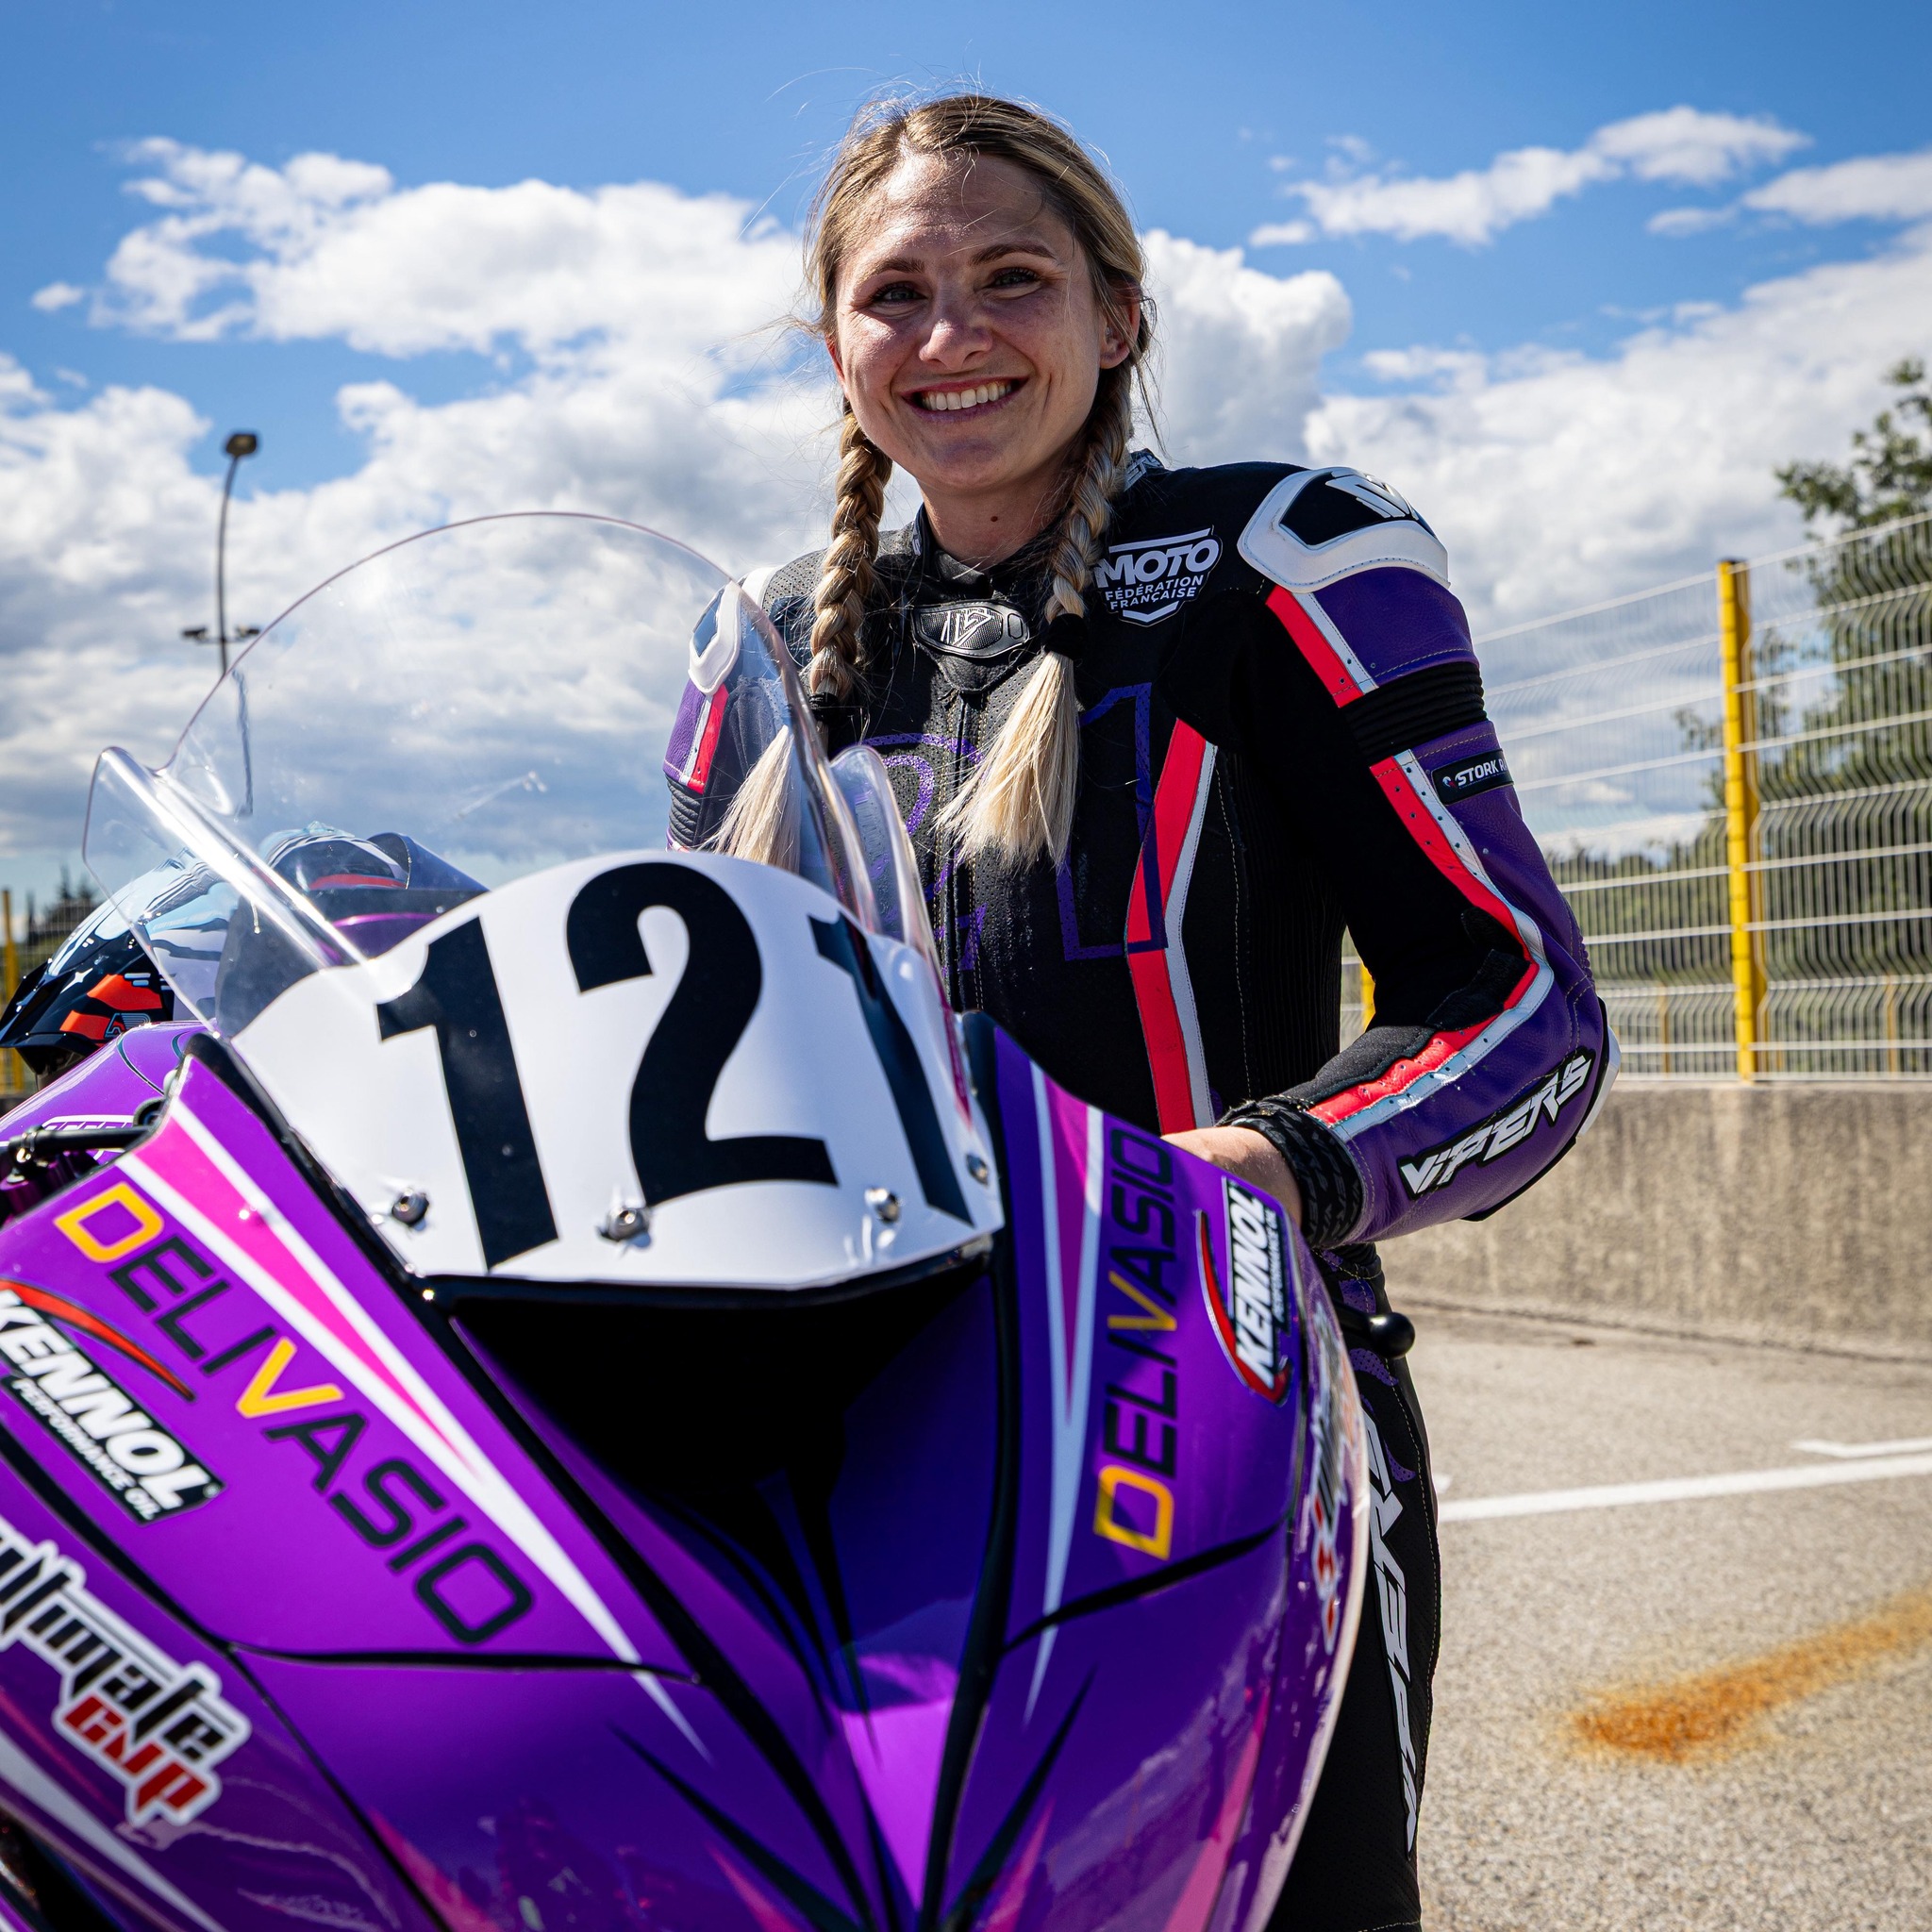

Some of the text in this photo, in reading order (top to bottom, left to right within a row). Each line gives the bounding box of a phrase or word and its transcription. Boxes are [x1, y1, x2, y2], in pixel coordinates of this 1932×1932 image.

[1094, 539, 1219, 588] MOTO
[1105, 575, 1204, 601] FÉDÉRATION
[1110, 587, 1197, 609] FRANÇAISE
[1455, 758, 1498, 786] STORK
[375, 860, 975, 1274] 121
[1401, 1055, 1592, 1194] VIPERS
[1092, 1128, 1177, 1561] DELIVASIO
[1228, 1185, 1275, 1390] KENNOL
[12, 1376, 161, 1521] PERFORMANCE OIL
[54, 1181, 535, 1644] DELIVASIO
